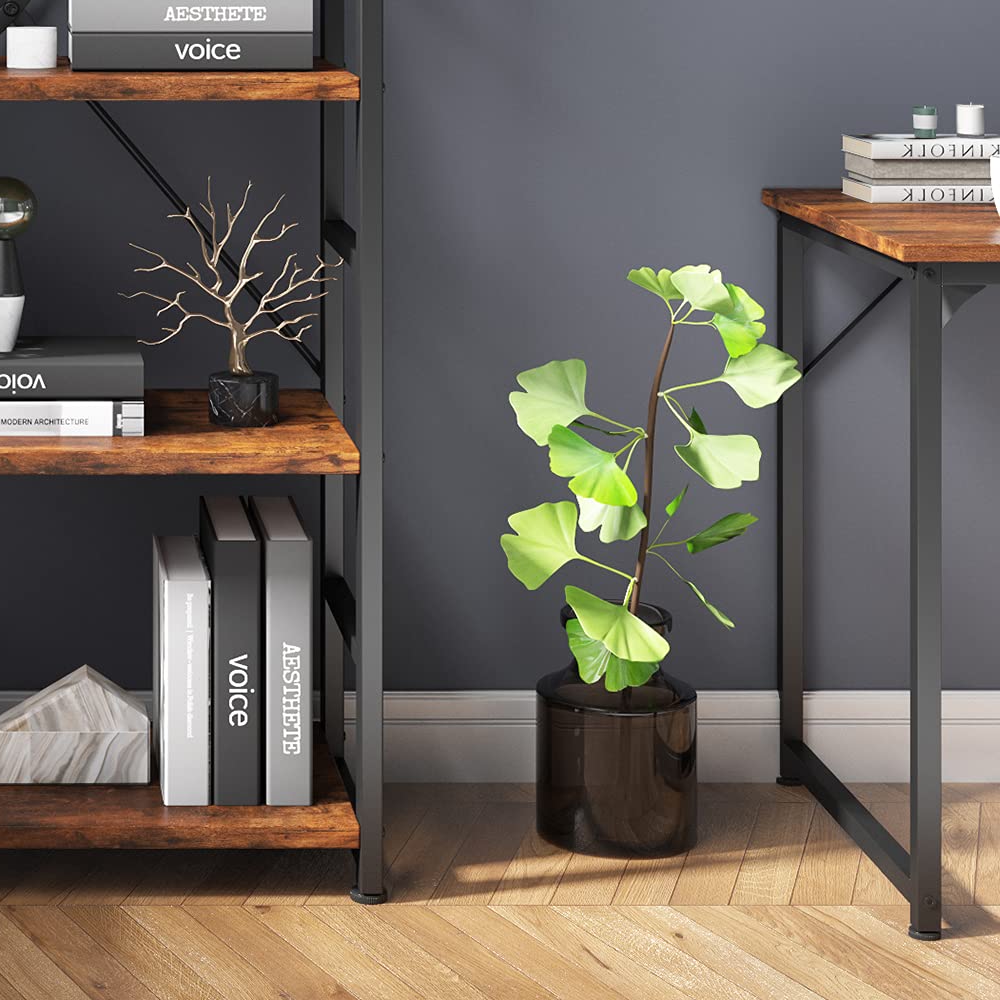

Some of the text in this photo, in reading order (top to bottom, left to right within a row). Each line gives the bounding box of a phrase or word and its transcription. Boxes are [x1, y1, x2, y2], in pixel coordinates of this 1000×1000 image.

[163, 6, 267, 22] AESTHETE
[175, 38, 241, 60] voice
[1, 418, 89, 426] MODERN ARCHITECTURE
[229, 654, 255, 727] voice
[283, 642, 301, 754] AESTHETE
